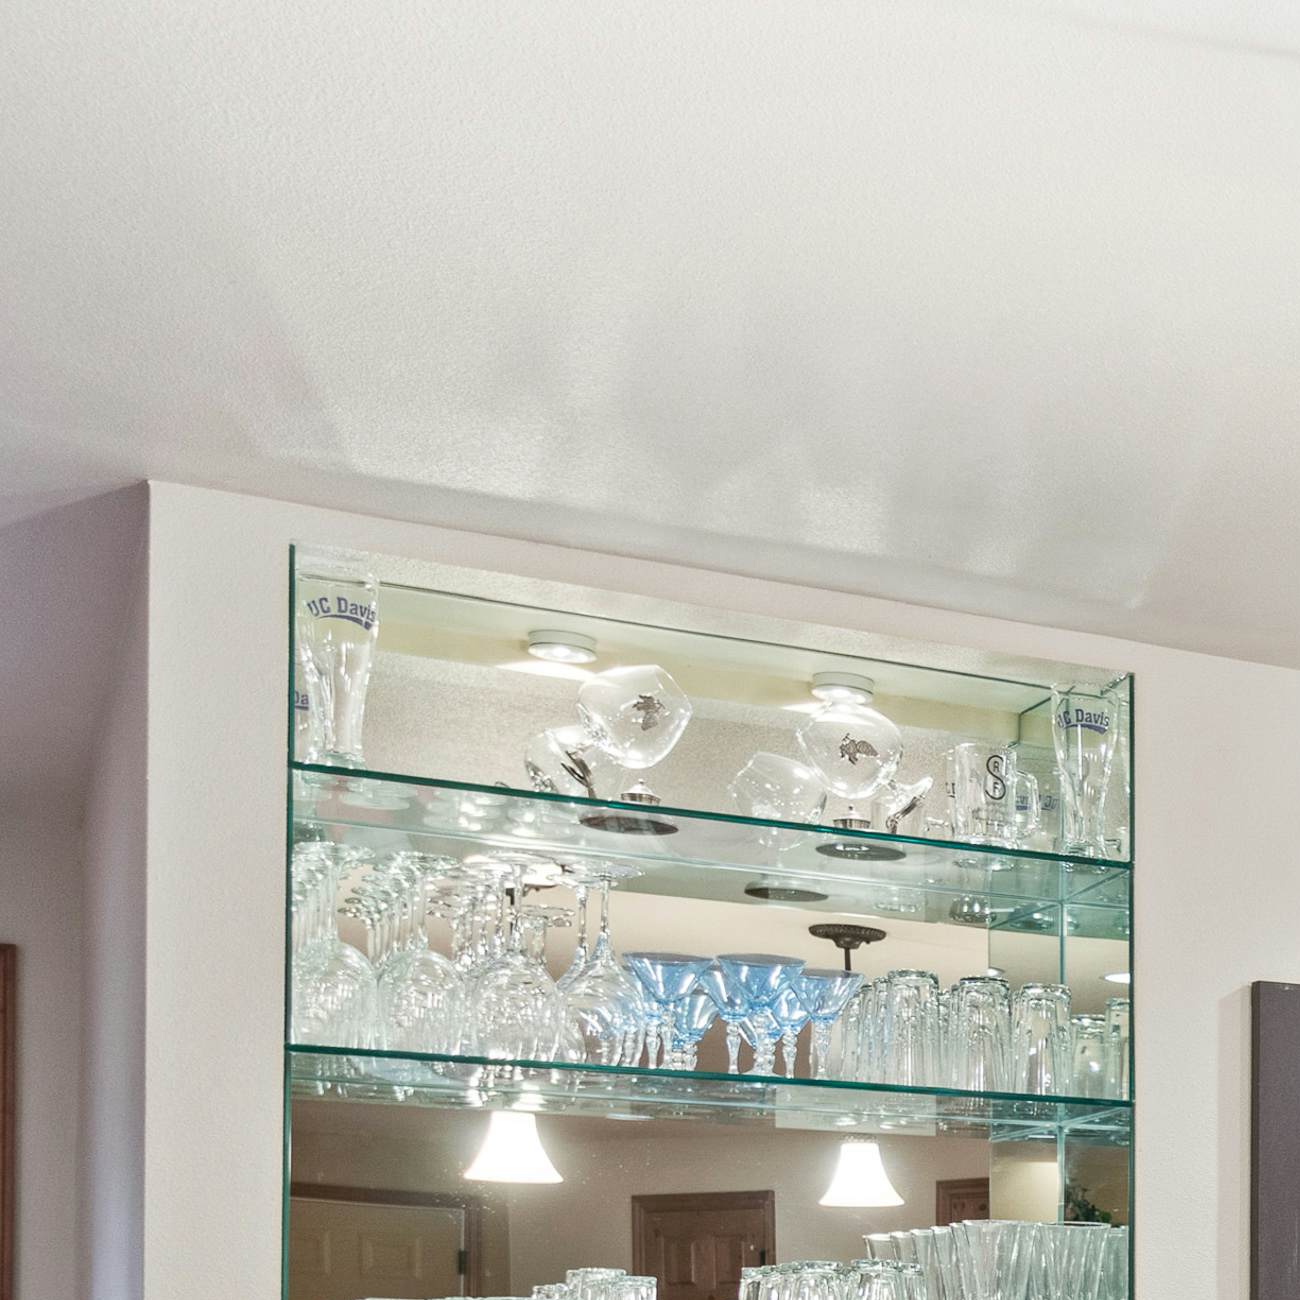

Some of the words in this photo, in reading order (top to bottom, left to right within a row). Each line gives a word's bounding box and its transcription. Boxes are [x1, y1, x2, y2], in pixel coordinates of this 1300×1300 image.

[307, 597, 330, 617] UC
[336, 596, 376, 622] Davis
[1075, 708, 1110, 727] Davis
